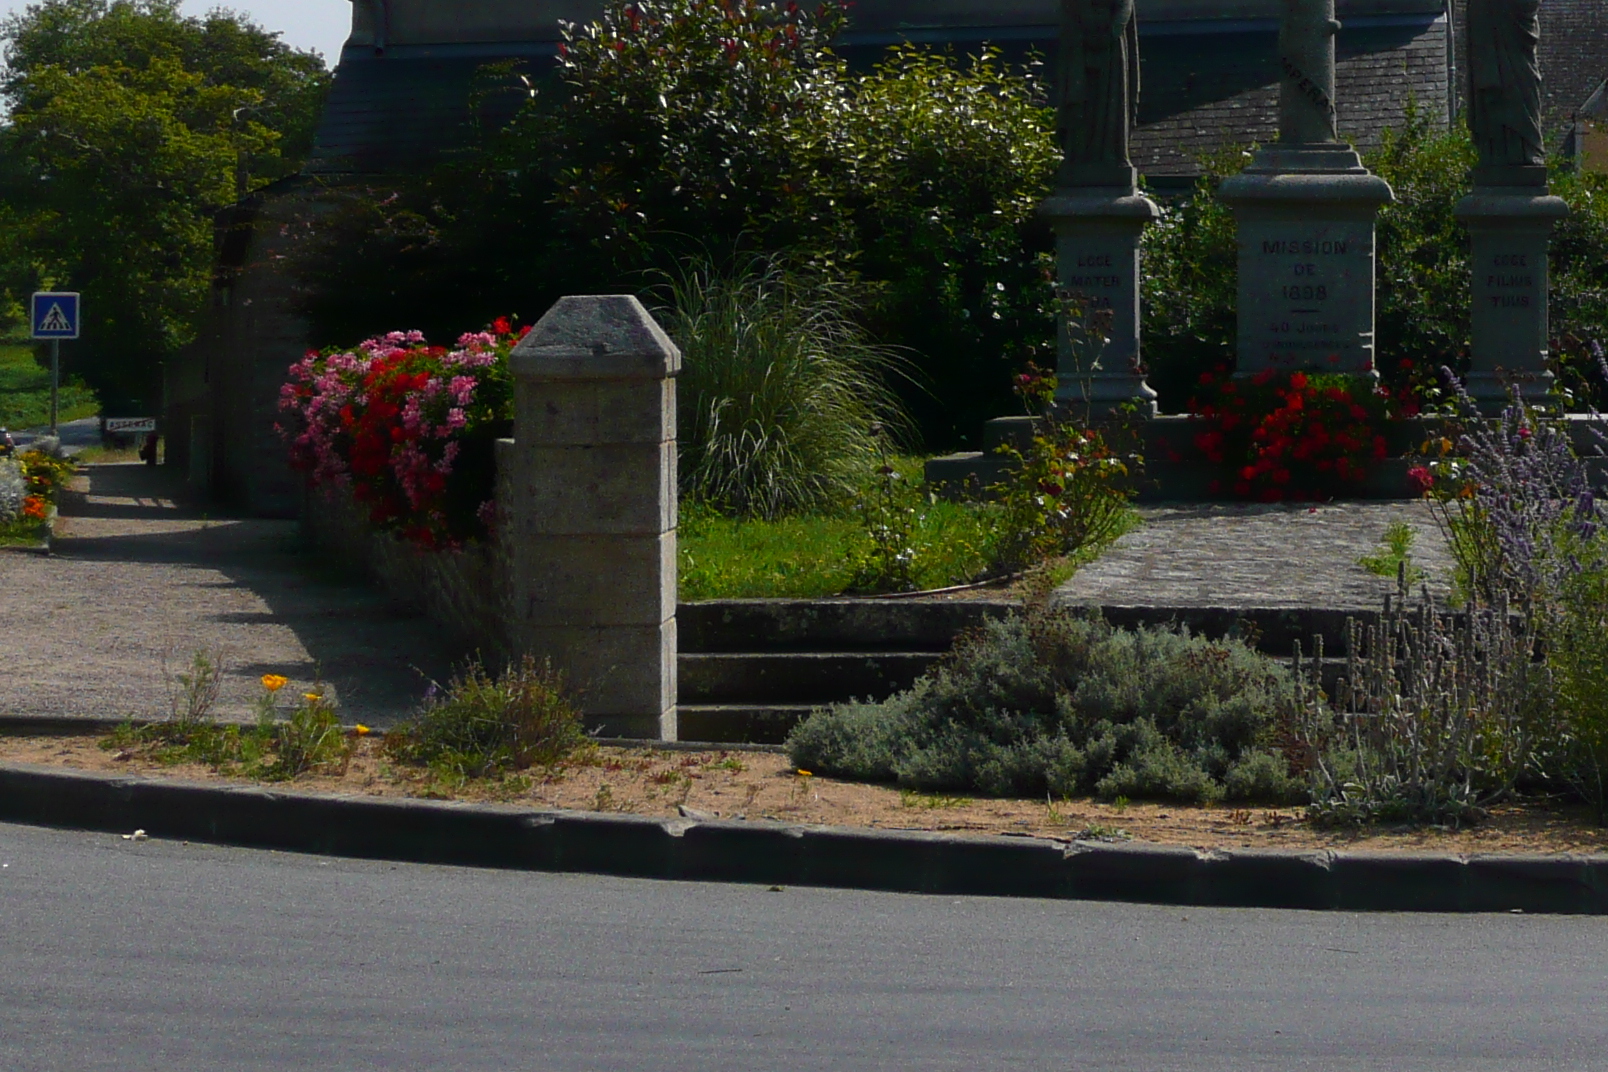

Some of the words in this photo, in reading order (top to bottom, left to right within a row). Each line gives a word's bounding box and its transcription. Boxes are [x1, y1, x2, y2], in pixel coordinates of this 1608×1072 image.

[1263, 240, 1347, 255] MISSION
[1294, 264, 1316, 276] DE
[1070, 275, 1120, 287] MATER
